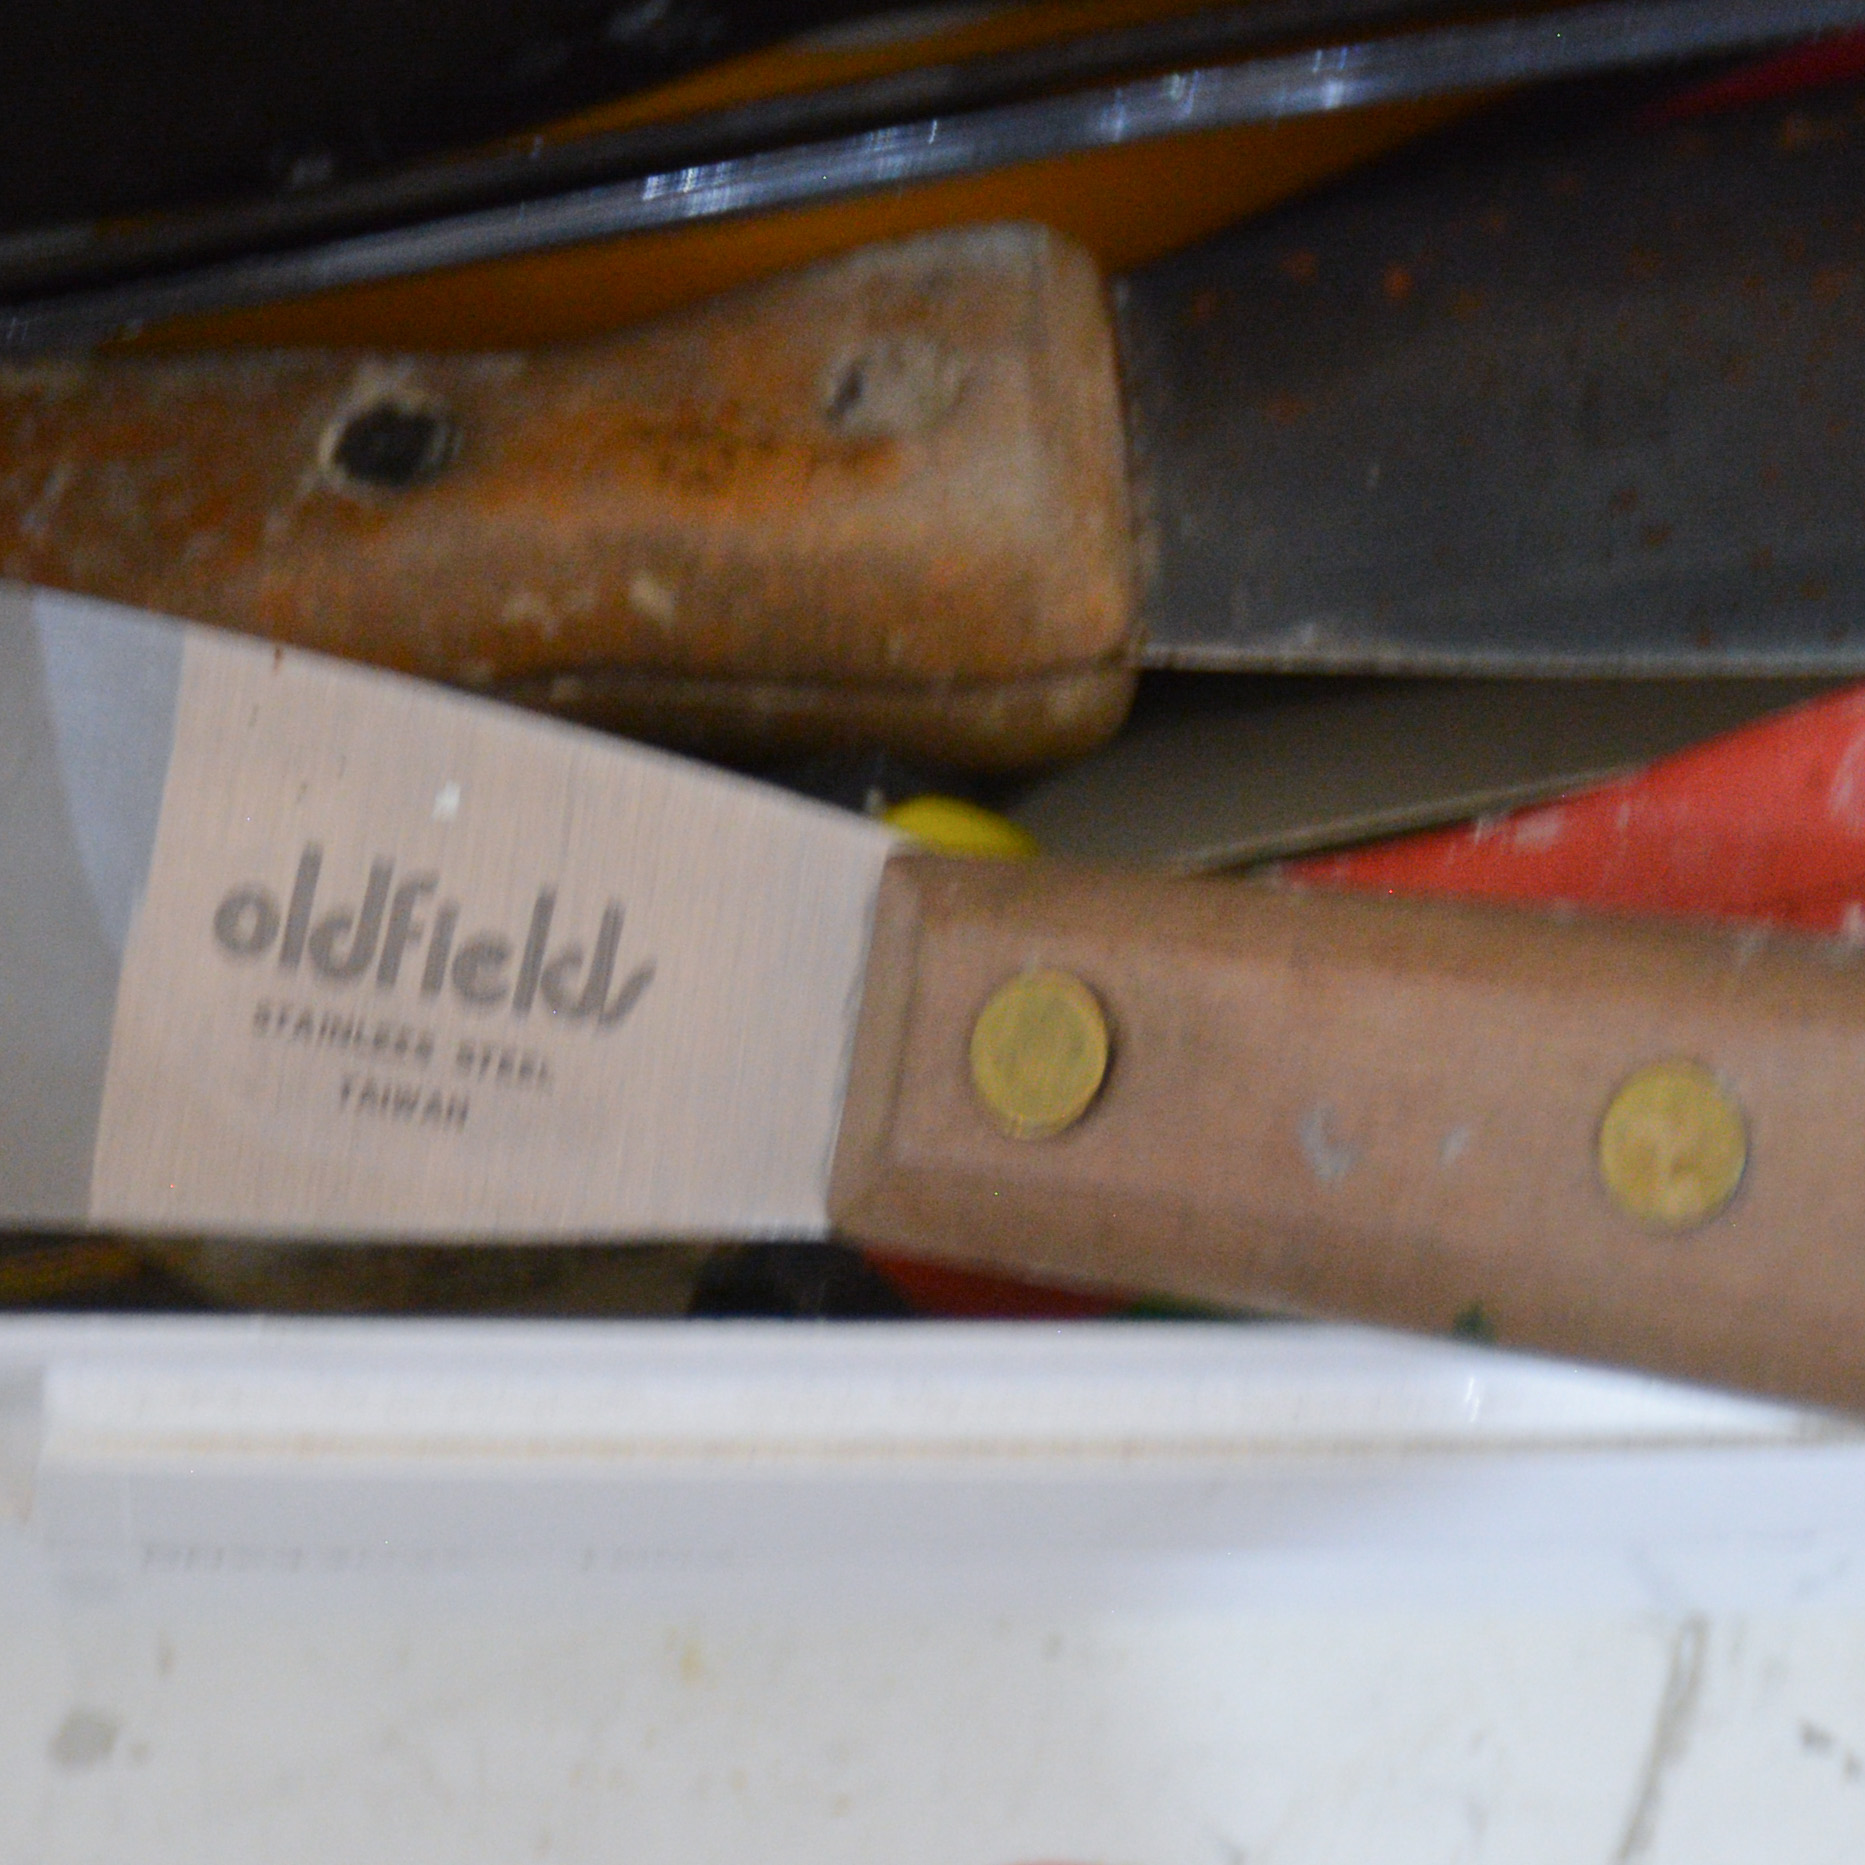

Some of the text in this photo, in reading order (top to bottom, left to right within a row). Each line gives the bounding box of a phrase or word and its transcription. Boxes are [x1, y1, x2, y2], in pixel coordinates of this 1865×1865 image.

[253, 998, 553, 1091] STAINLESS STEEL
[340, 1073, 471, 1131] TAIWAN
